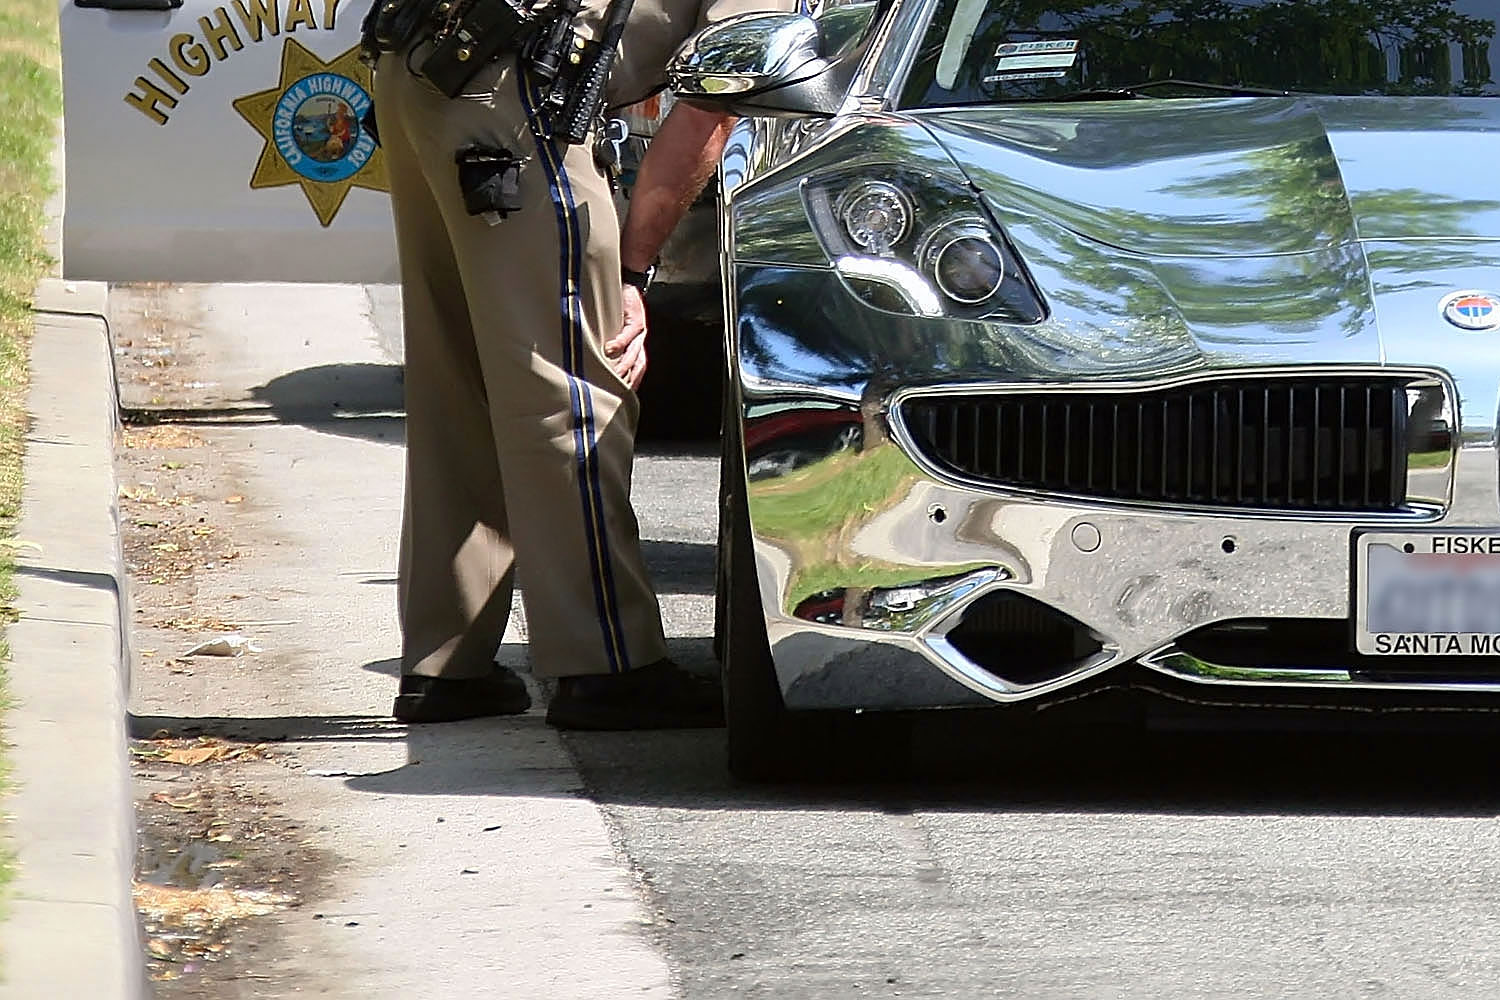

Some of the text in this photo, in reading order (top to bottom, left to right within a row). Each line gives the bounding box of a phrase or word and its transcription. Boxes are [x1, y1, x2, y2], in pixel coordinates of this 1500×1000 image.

[1019, 40, 1074, 49] FISKER
[276, 86, 307, 165] CALIFORNIA
[308, 76, 371, 114] HIGHWAY
[1376, 634, 1463, 654] SANTA
